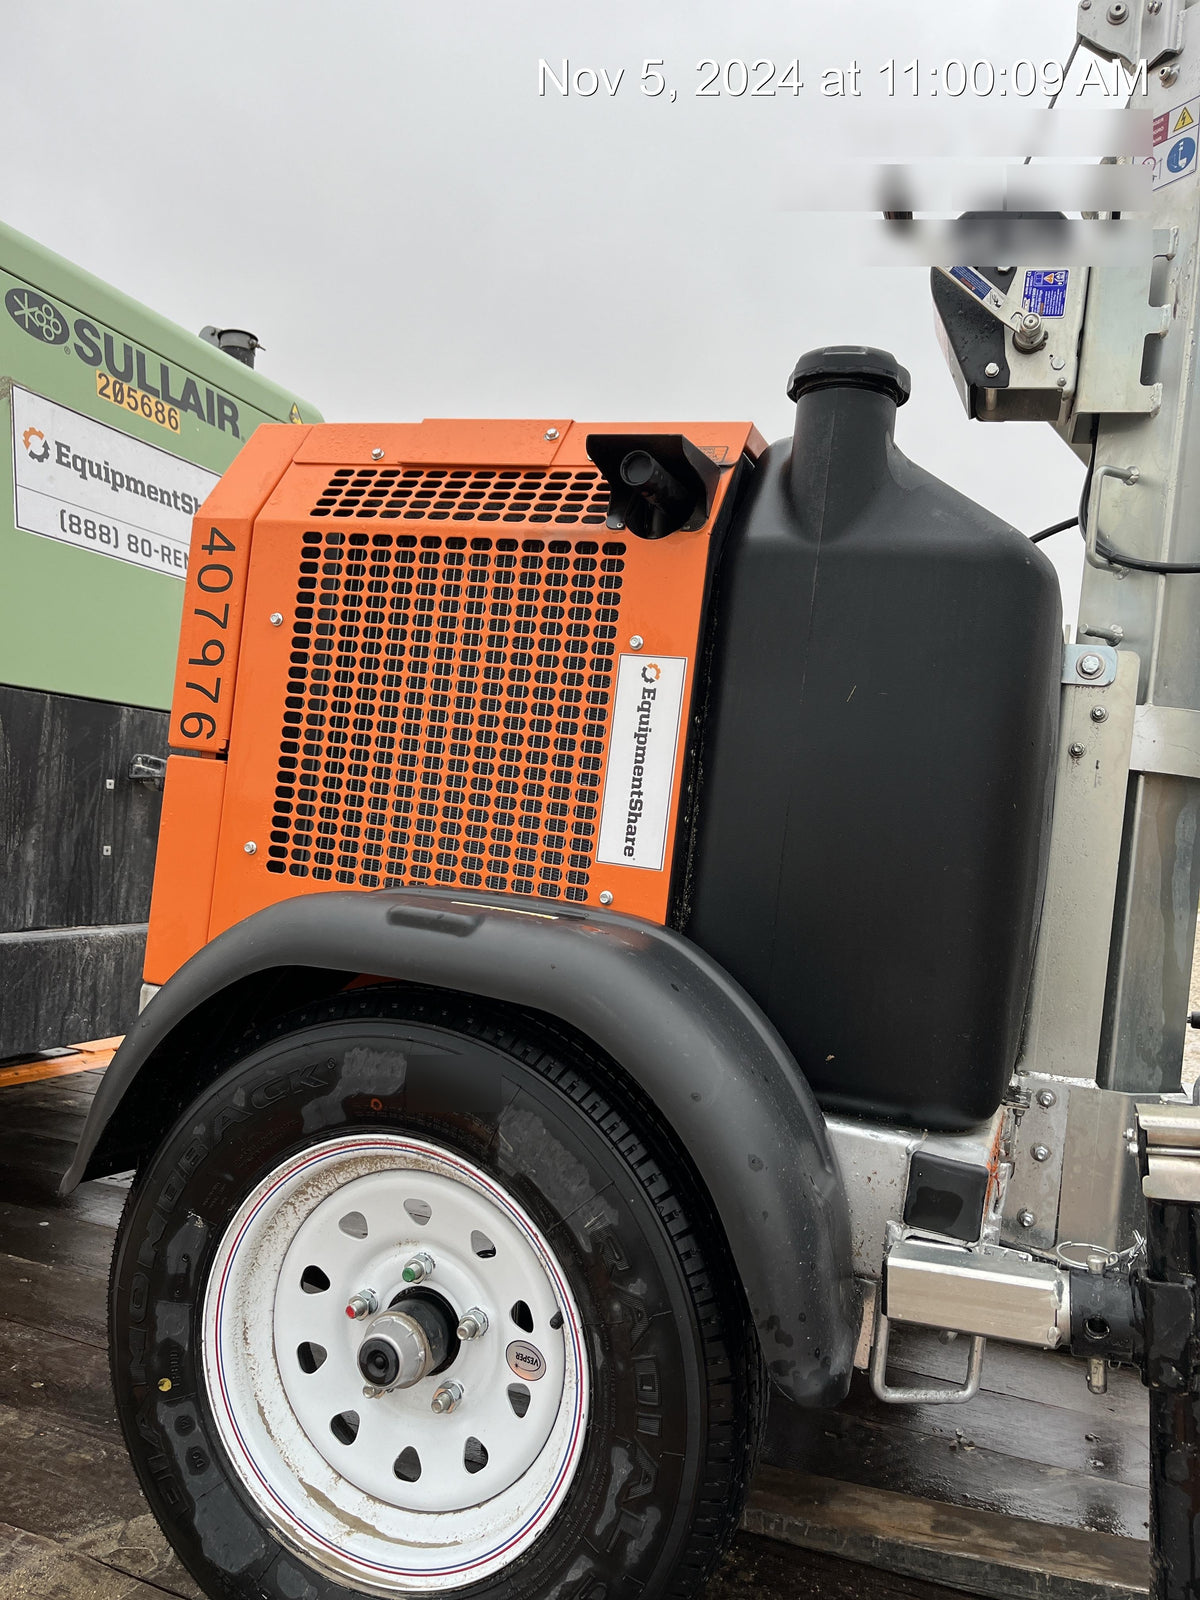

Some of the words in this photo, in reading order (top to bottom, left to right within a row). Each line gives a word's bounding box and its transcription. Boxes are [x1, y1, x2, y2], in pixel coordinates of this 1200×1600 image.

[73, 318, 242, 440] SULLAIR
[59, 508, 120, 550] (888)
[180, 526, 236, 740] 407976
[623, 686, 657, 858] EquipmentShare
[515, 1351, 539, 1367] VESPER
